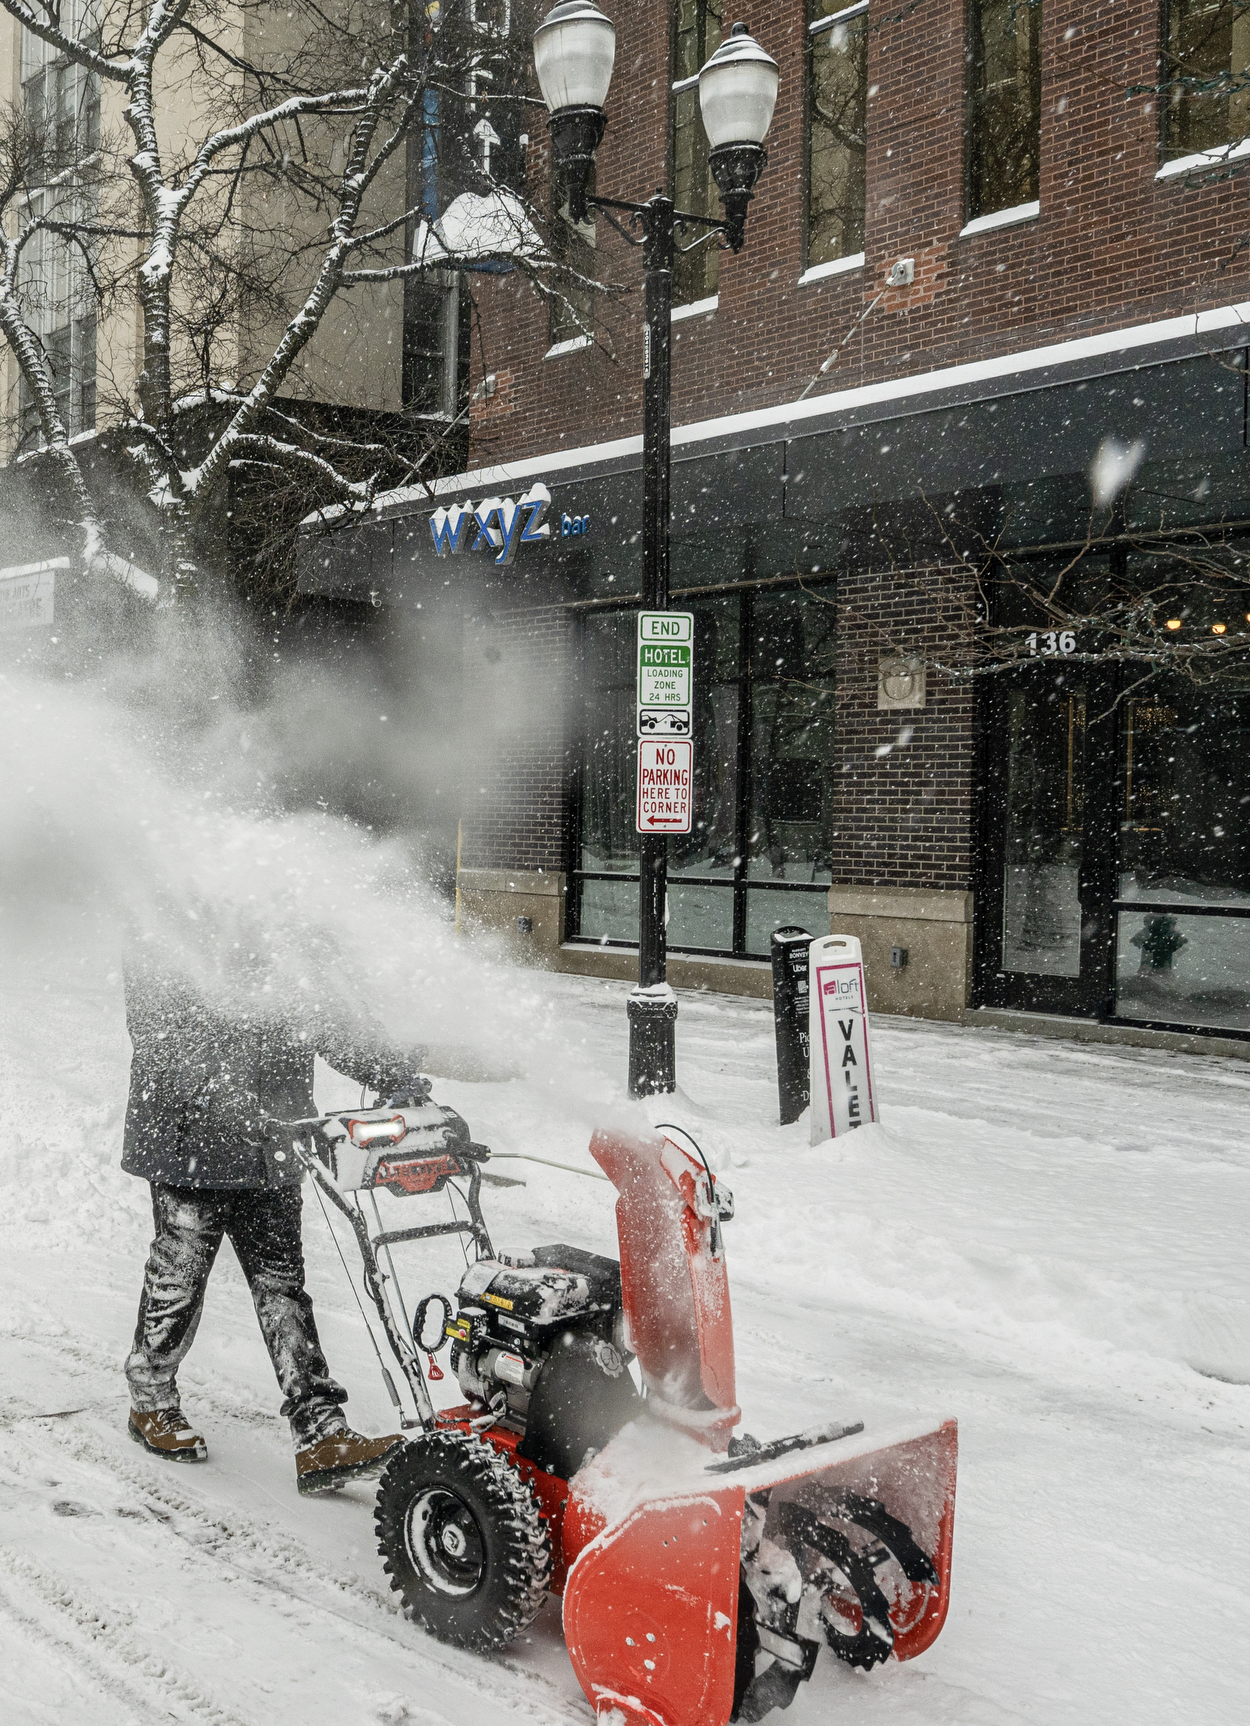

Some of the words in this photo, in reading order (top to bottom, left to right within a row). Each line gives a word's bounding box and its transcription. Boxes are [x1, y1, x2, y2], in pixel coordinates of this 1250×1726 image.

[429, 498, 546, 565] wxyz
[561, 513, 590, 537] bar
[651, 621, 680, 635] END
[1025, 631, 1076, 656] 136
[644, 648, 686, 664] HOTEL
[647, 669, 683, 678] LOADING
[654, 681, 676, 689] ZONE
[649, 692, 660, 701] 24
[664, 693, 681, 701] HRS
[656, 748, 676, 766] NO
[642, 768, 688, 786] PARKING
[642, 787, 671, 800] HERE
[674, 788, 688, 800] TO
[643, 801, 687, 814] CORNER
[793, 964, 808, 973] Uber
[823, 978, 859, 996] aloft
